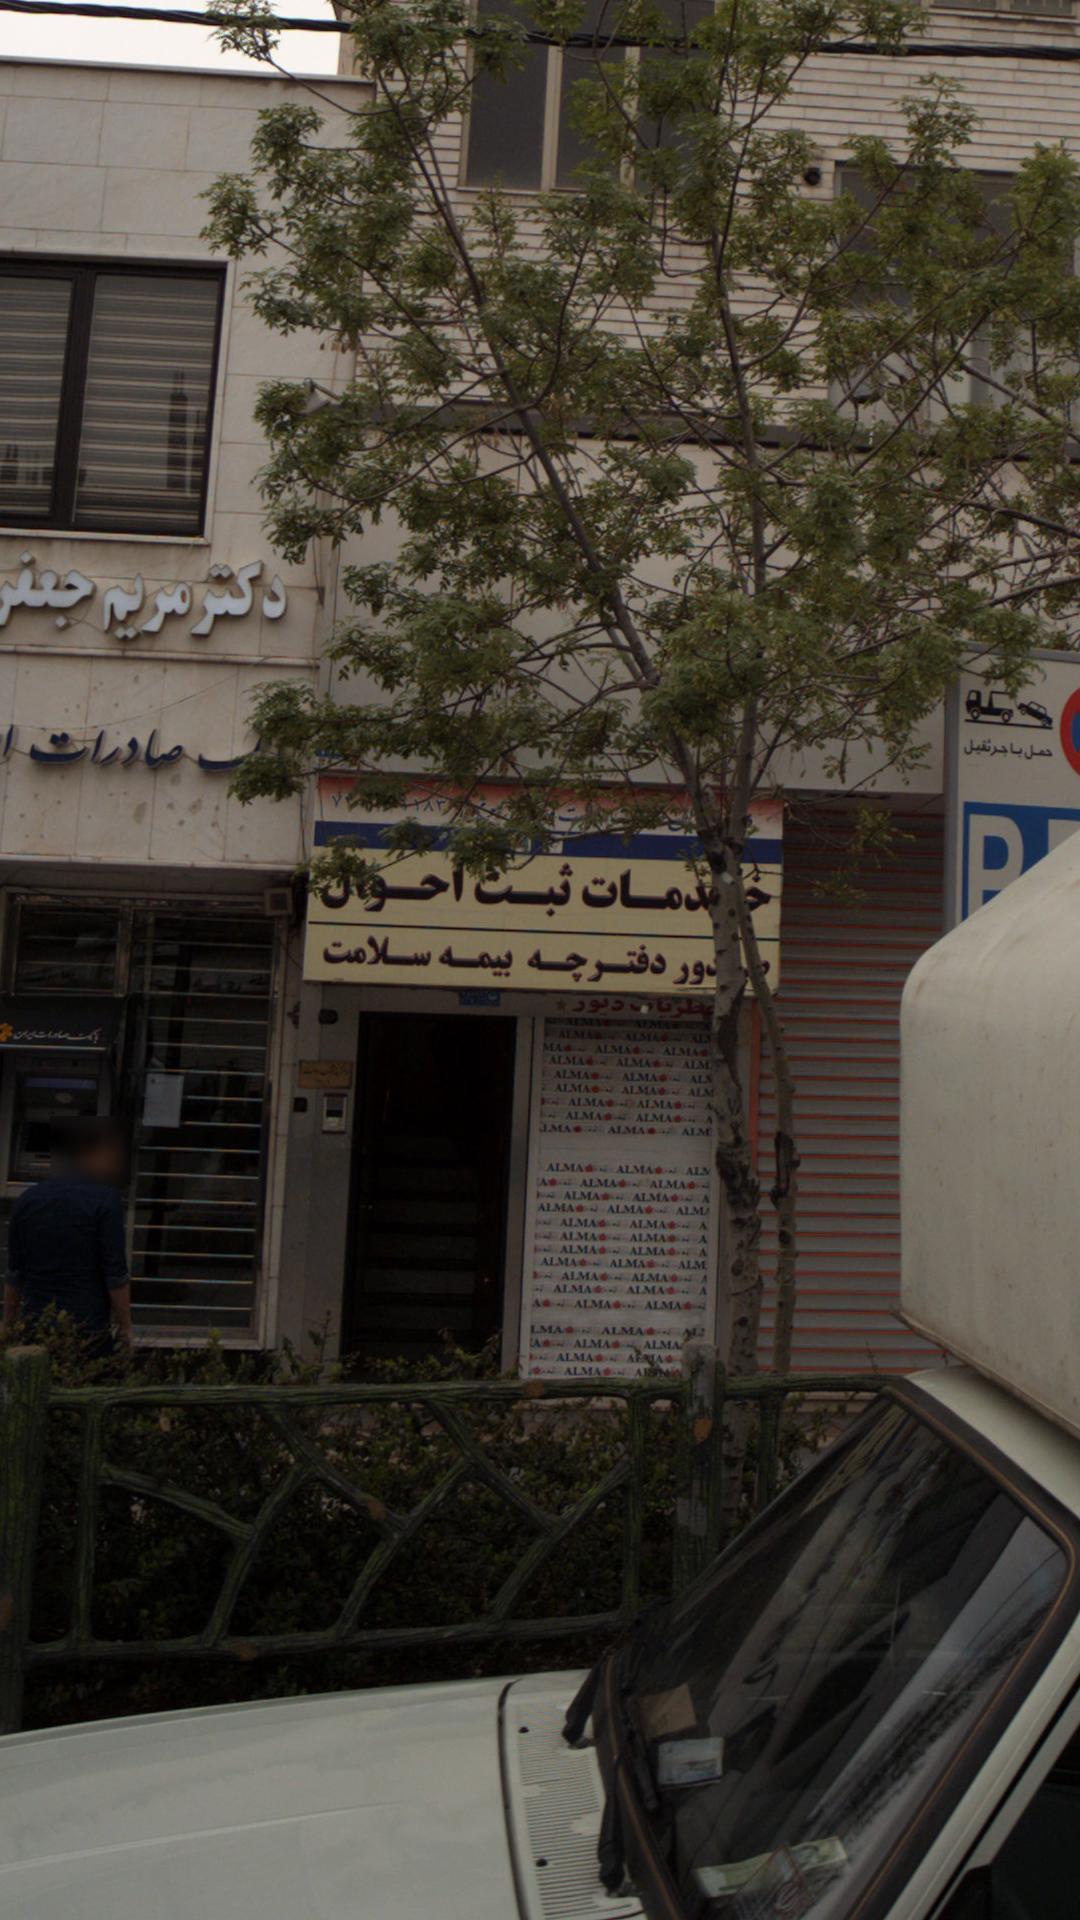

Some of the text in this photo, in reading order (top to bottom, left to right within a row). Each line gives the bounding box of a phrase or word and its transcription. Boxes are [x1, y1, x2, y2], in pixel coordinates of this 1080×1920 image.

[190, 560, 288, 637] دکتر
[102, 572, 194, 640] مریم
[30, 728, 184, 769] صادرات
[474, 862, 572, 917] ثبت
[582, 868, 772, 911] خدمات
[323, 935, 432, 966] سلامت
[439, 945, 513, 978] بیمه
[528, 944, 667, 982] دفترچه
[560, 1031, 595, 1040] ALMA
[625, 1033, 659, 1041] ALMA
[595, 1045, 631, 1054] ALMA
[663, 1047, 698, 1056] ALMA
[550, 1056, 584, 1065] ALMA
[618, 1058, 652, 1067] ALMA
[553, 1070, 591, 1079] ALMA
[622, 1073, 658, 1082] ALMA
[555, 1084, 591, 1092] ALMA
[622, 1086, 658, 1094] ALMA
[569, 1098, 672, 1109] ALMA ALMA
[566, 1112, 671, 1122] ALMA ALMA
[608, 1126, 644, 1134] ALMA
[547, 1164, 583, 1172] ALMA
[617, 1165, 652, 1174] ALMA
[580, 1180, 686, 1189] ALMA ALMA
[564, 1192, 669, 1202] ALMA ALMA
[538, 1204, 574, 1212] ALMA
[607, 1205, 644, 1214] ALMA
[561, 1219, 666, 1229] ALMA ALMA
[561, 1232, 666, 1242] ALMA ALMA
[561, 1246, 665, 1255] ALMA ALMA
[541, 1258, 577, 1266] ALMA
[610, 1260, 646, 1268] ALMA
[562, 1272, 668, 1282] ALMA ALMA
[554, 1285, 665, 1295] ALMA ALMA
[574, 1300, 681, 1310] ALMA ALMA
[602, 1327, 643, 1335] ALMA
[574, 1340, 680, 1349] ALMA ALMA
[557, 1353, 593, 1361] ALMA
[564, 1367, 600, 1376] ALMA
